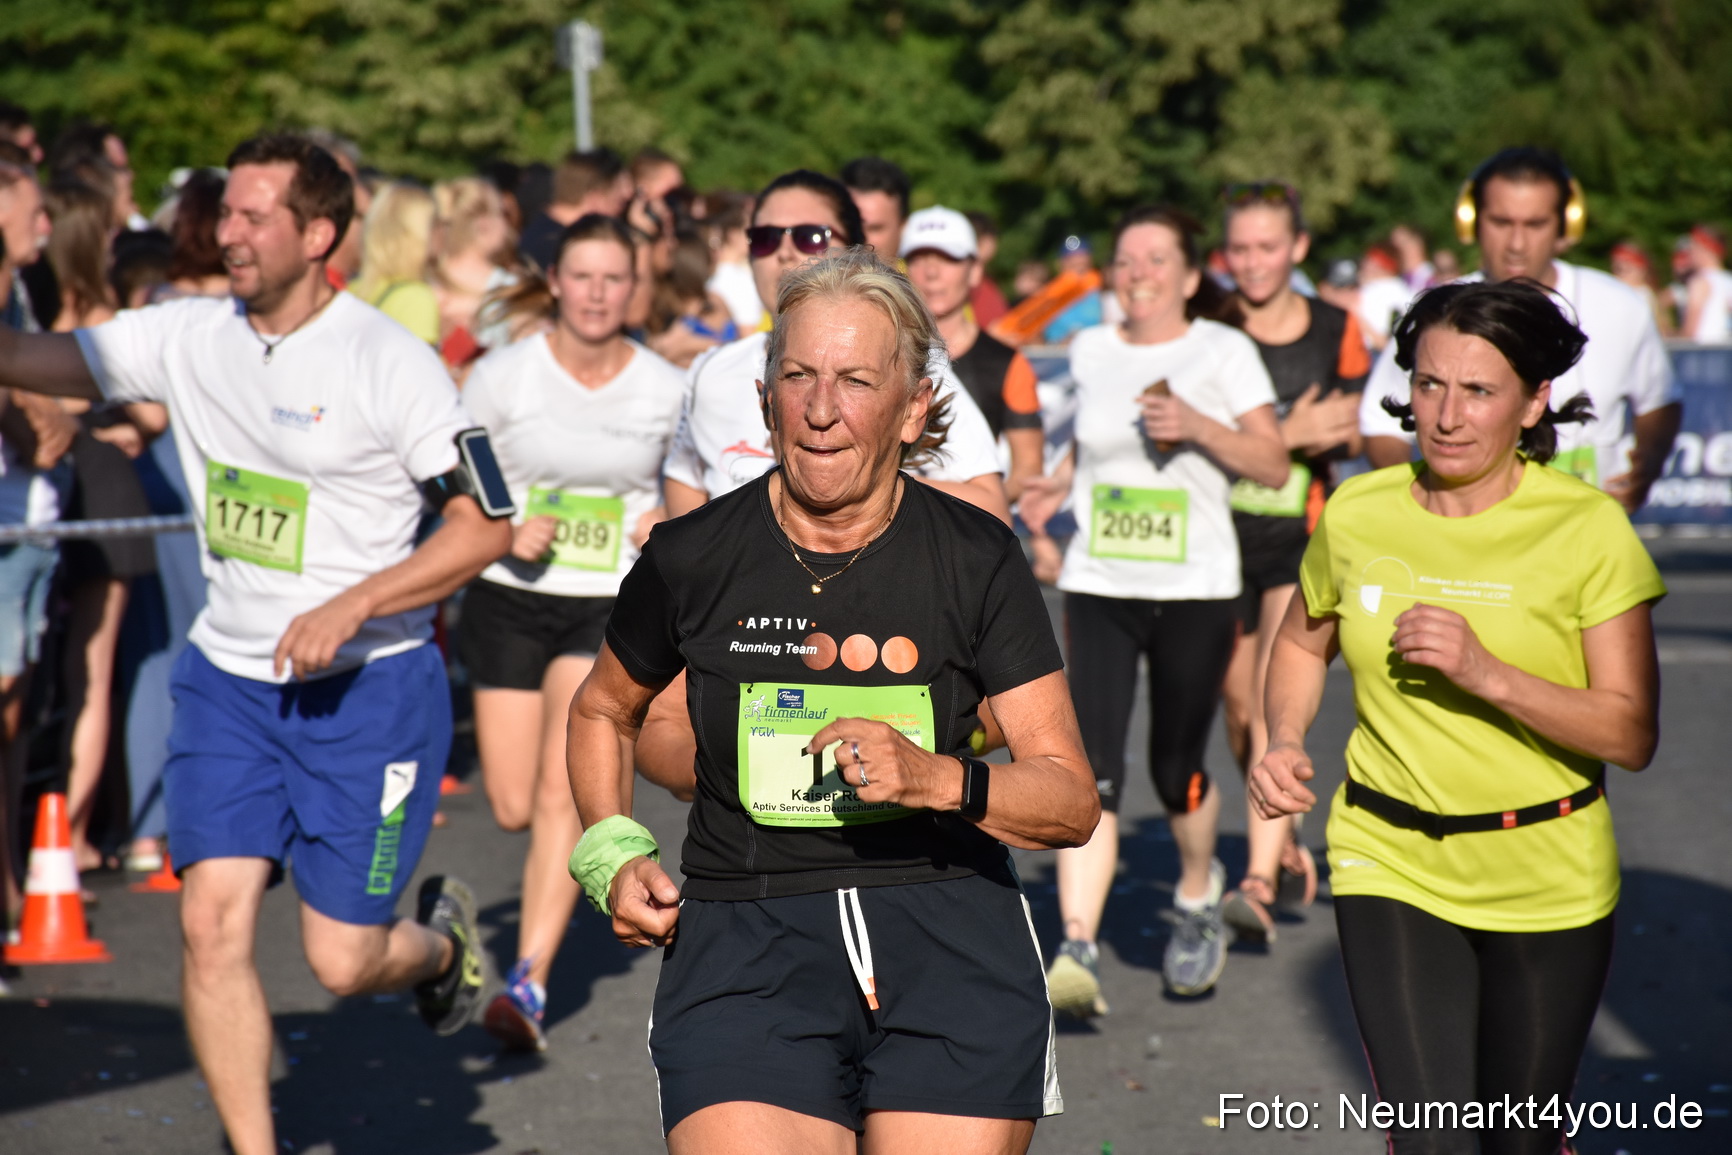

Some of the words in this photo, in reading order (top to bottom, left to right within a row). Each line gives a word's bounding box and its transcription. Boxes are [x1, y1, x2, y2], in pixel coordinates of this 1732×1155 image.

[216, 498, 289, 543] 1717
[1102, 511, 1172, 541] 2094
[1441, 587, 1481, 598] Neumarkt
[746, 617, 808, 630] APTIV
[729, 641, 781, 656] Running
[785, 642, 818, 655] Team
[764, 705, 829, 720] firmenlauf
[791, 788, 838, 802] Kaiser
[752, 801, 777, 812] Aptiv
[779, 803, 821, 813] Services
[823, 803, 884, 813] Deutschland
